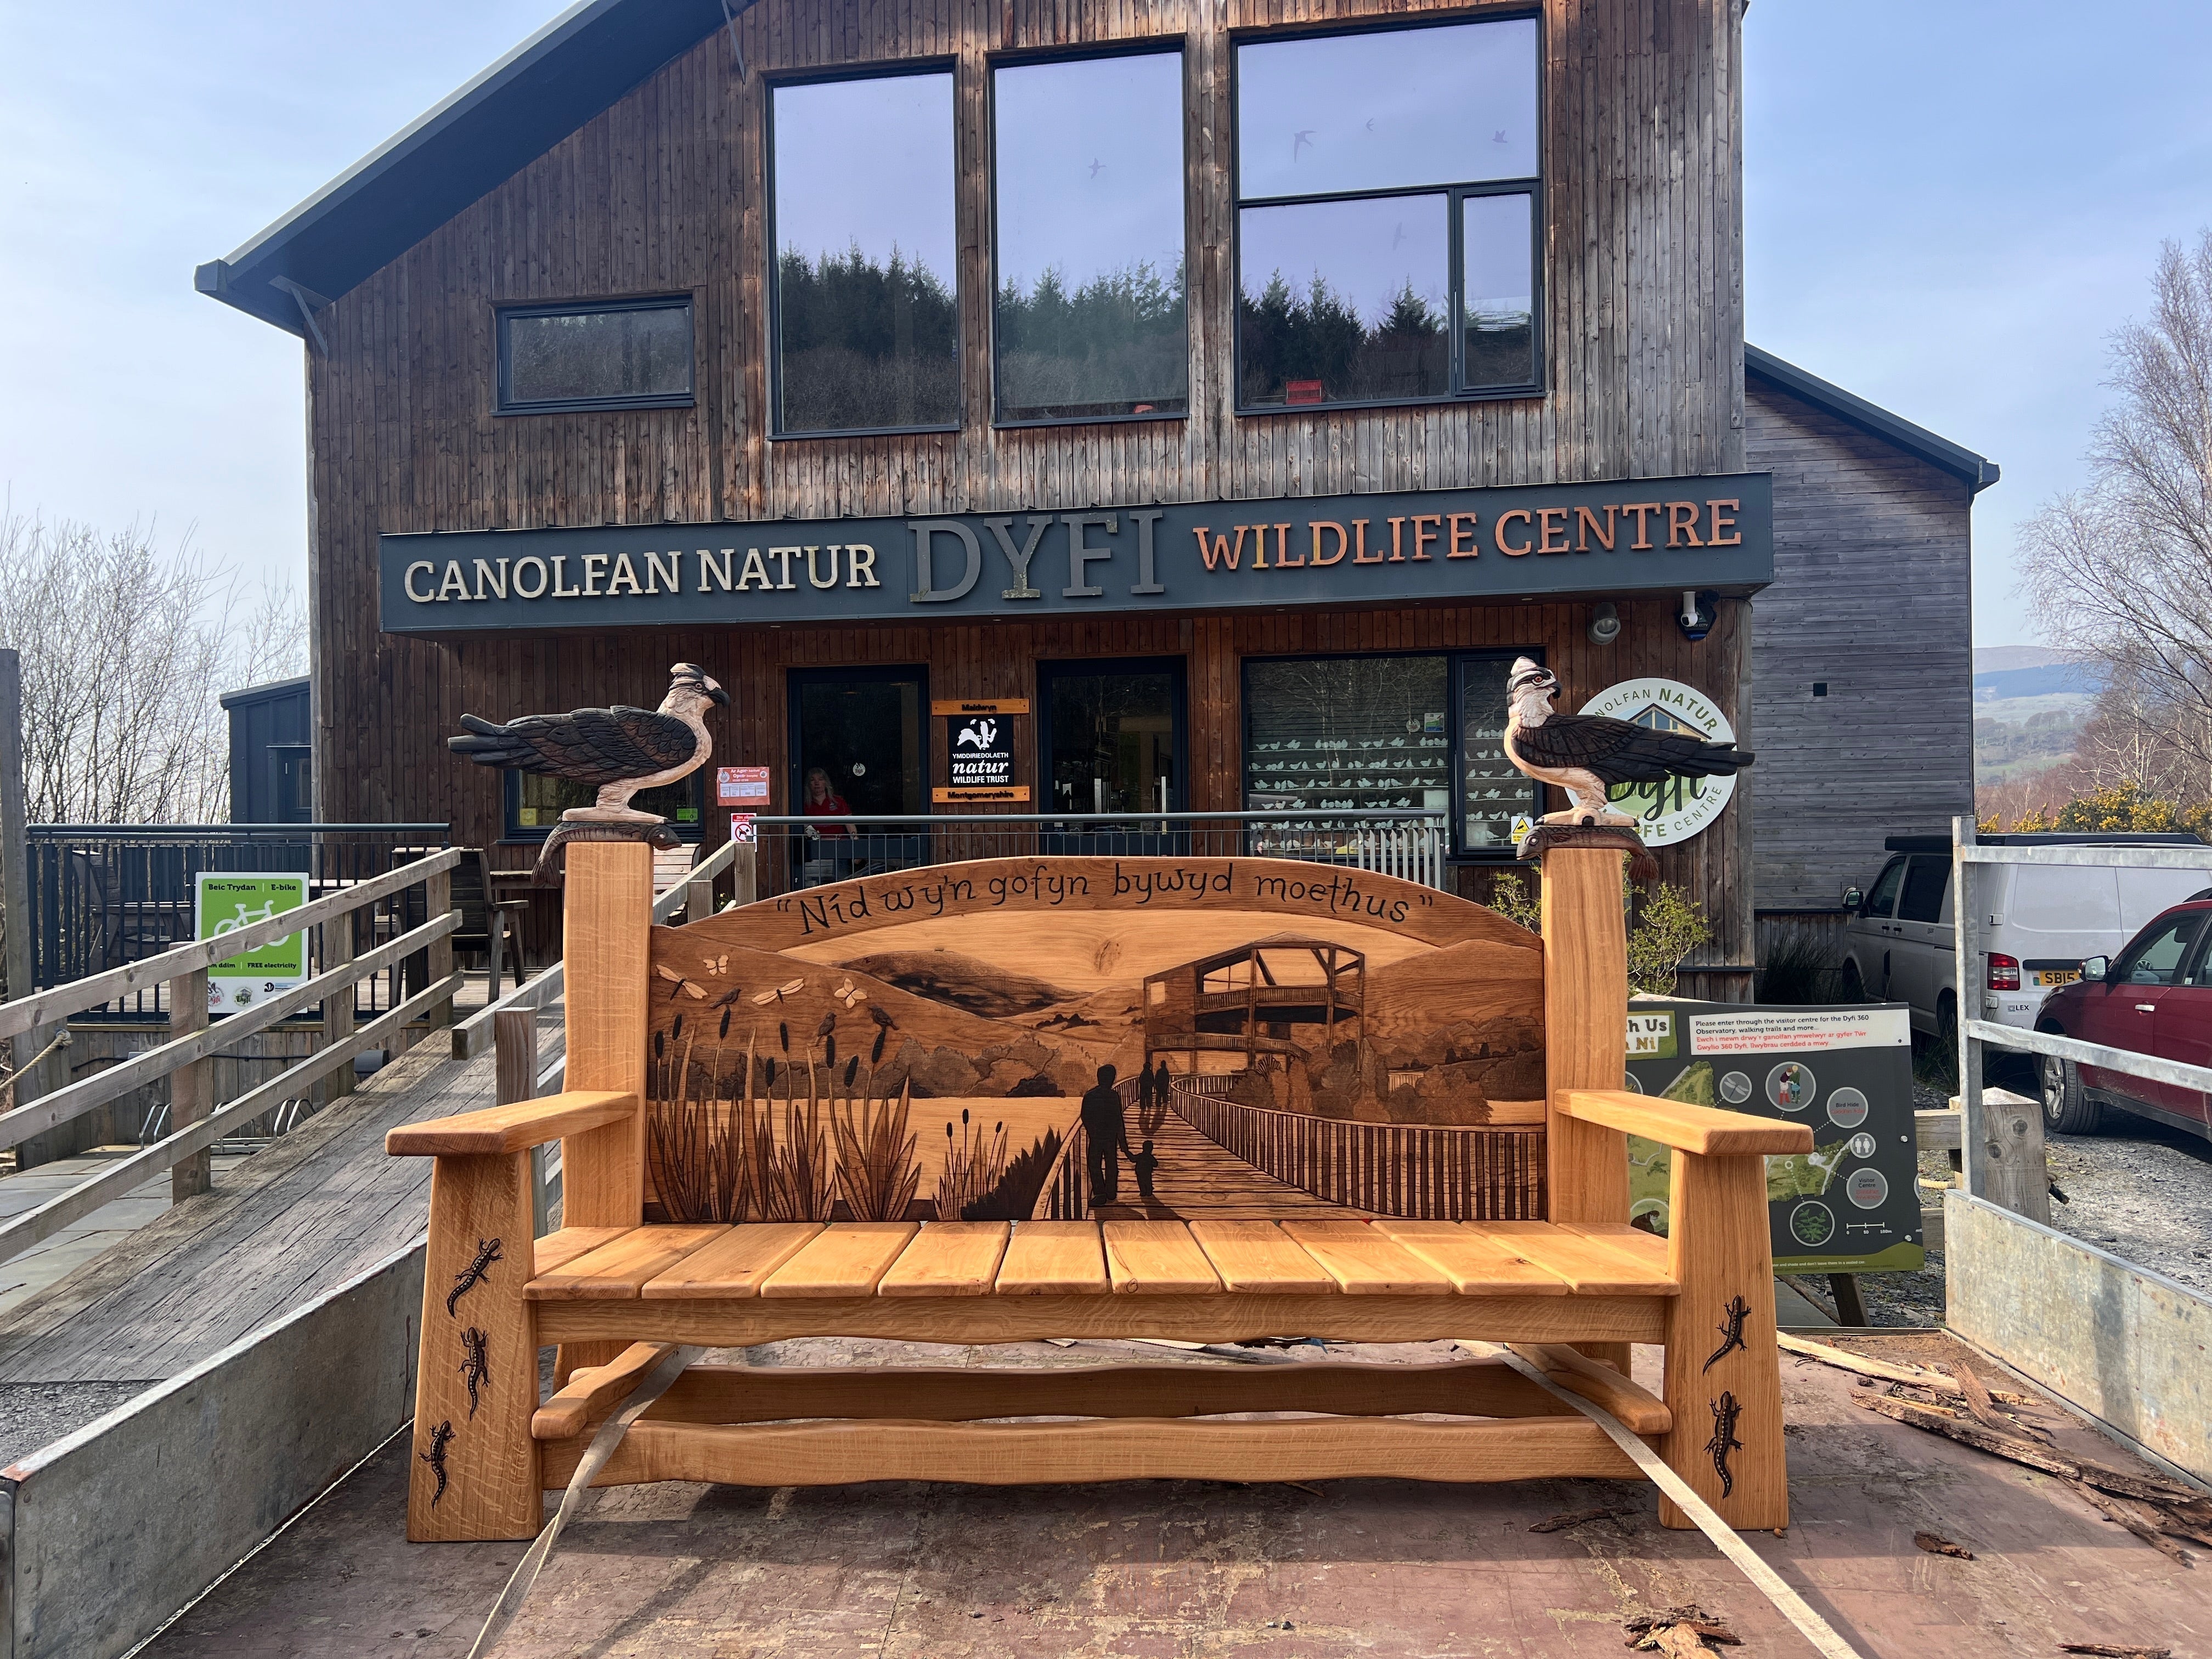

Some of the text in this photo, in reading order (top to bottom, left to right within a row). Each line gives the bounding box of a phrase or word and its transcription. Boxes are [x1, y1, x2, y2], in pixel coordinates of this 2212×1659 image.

[405, 498, 1741, 603] CANOLFAN NATUR DYFI WILDLIFE CENTRE
[962, 704, 997, 712] Maldwyn
[1595, 688, 1717, 731] NOLFAN NATUR
[952, 760, 1008, 774] natur
[986, 775, 1009, 783] TRUST
[947, 790, 1014, 800] Montgomeryshire
[1674, 786, 1722, 831] CENTRE
[227, 884, 256, 892] Trydan
[989, 865, 1091, 906] gofyn
[1113, 862, 1233, 904] bywyd
[1645, 1019, 1667, 1032] Us
[1636, 1036, 1656, 1050] Ni
